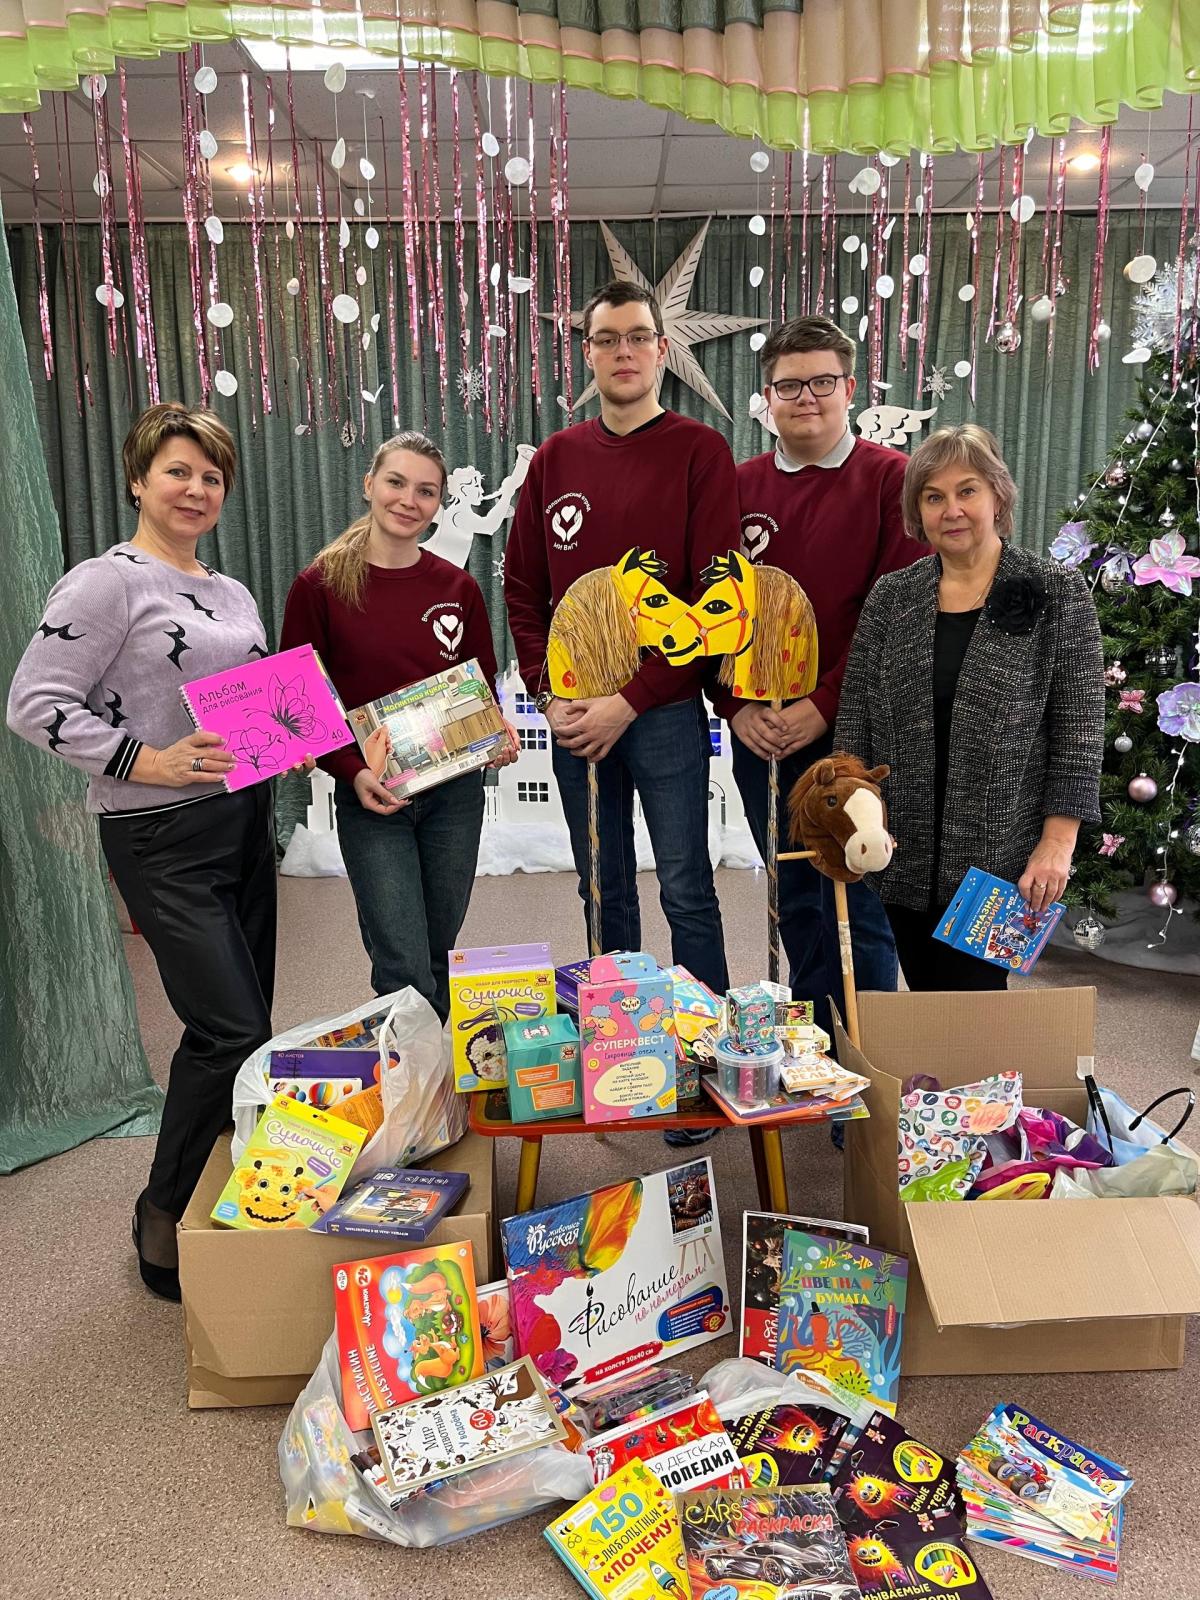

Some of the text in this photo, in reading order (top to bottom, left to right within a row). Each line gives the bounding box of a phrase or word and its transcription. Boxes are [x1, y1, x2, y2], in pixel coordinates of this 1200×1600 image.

[199, 681, 247, 704] Альбом
[203, 687, 263, 714] для рисования
[332, 729, 344, 741] 40
[965, 887, 1001, 945] АЛМАЗНАЯ
[975, 897, 1005, 944] МОЗАИКА
[459, 986, 545, 1010] Сумочка
[594, 1034, 665, 1052] СУПЕРКВЕСТ
[267, 1121, 341, 1168] Сумочка
[528, 1226, 579, 1255] Русская
[358, 1267, 368, 1285] 24
[568, 1265, 680, 1347] Рисование
[815, 1292, 870, 1305] БУМАГА
[604, 1361, 625, 1373] холсте
[645, 1348, 654, 1356] см
[366, 1344, 397, 1407] PLASTICINE
[432, 1411, 455, 1455] животных
[472, 1412, 488, 1428] 60
[422, 1426, 439, 1451] Мир
[667, 1436, 727, 1470] ДЕТСКАЯ
[1008, 1411, 1117, 1496] Раскраска
[590, 1492, 644, 1540] 150
[685, 1503, 743, 1524] CARS
[735, 1514, 834, 1536] РАСКРАСКА
[602, 1507, 662, 1562] ЛЮБОПЫТНЫХ
